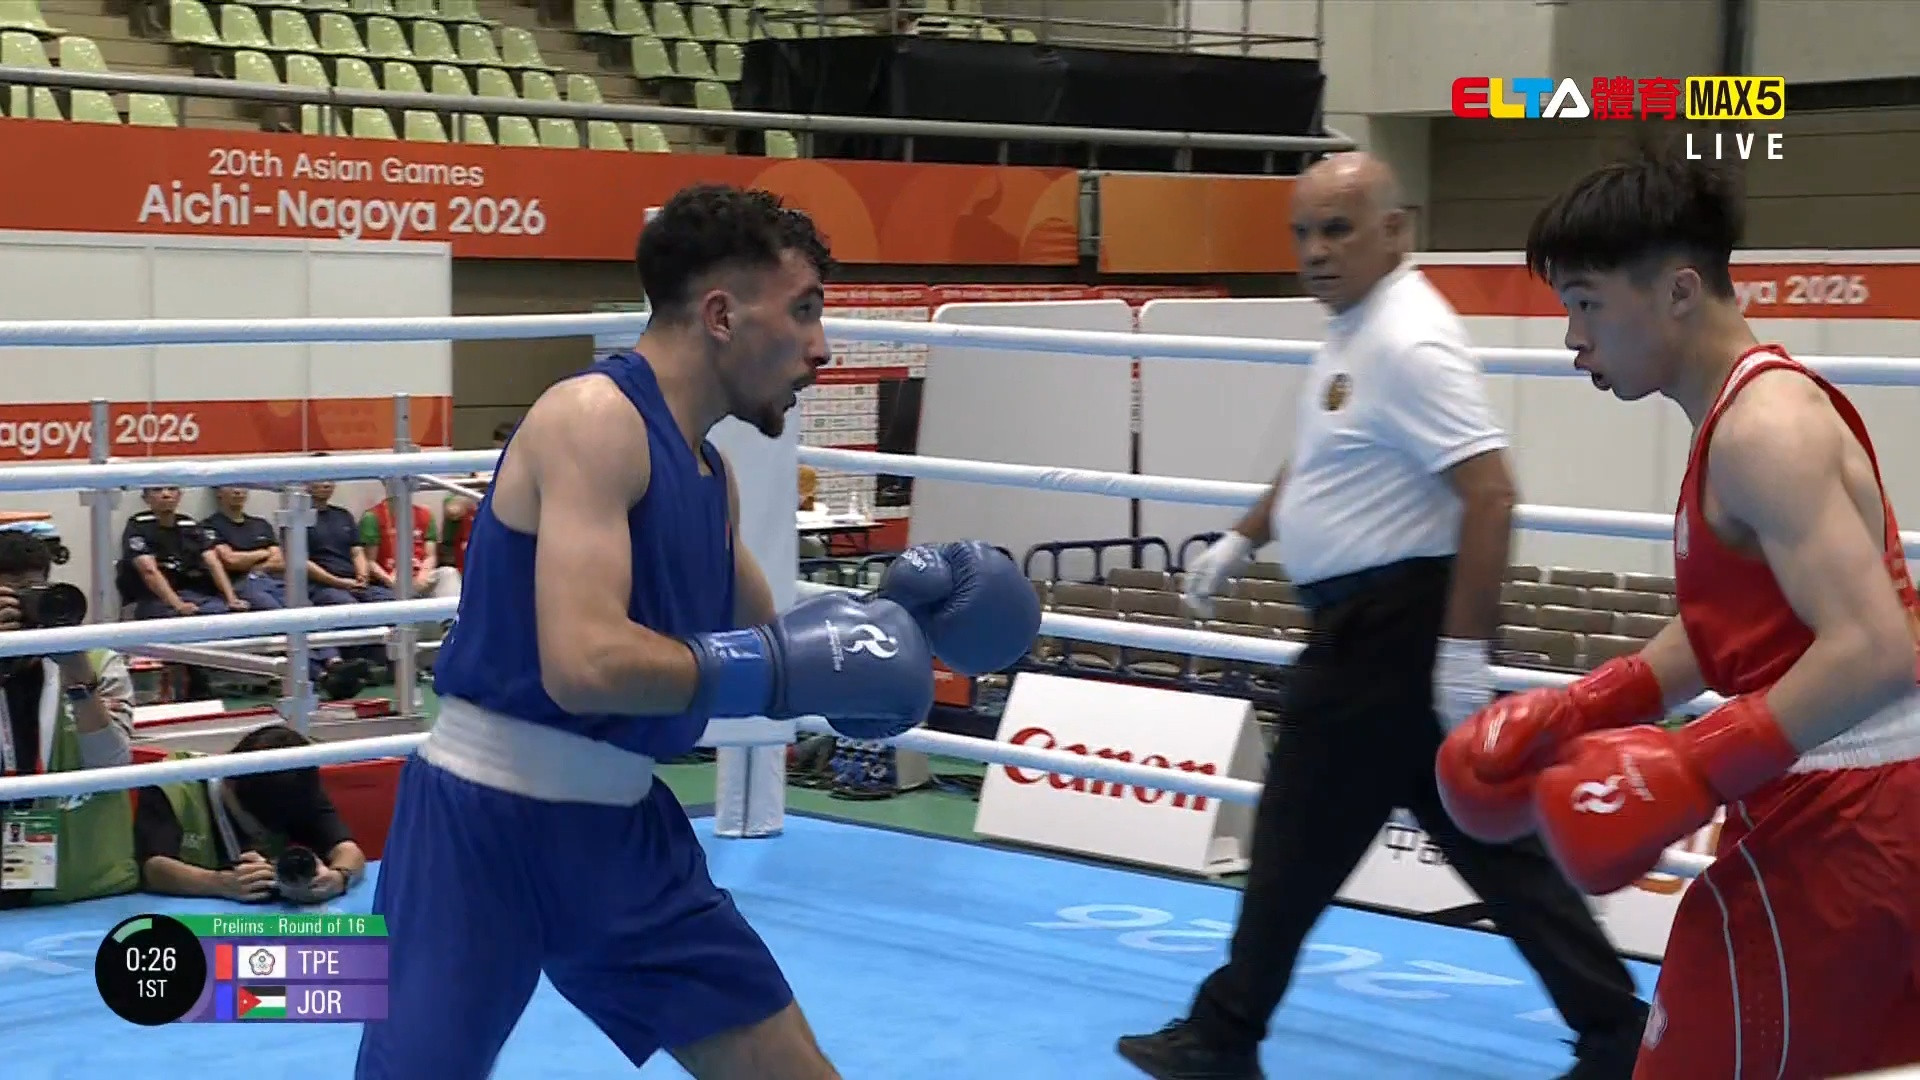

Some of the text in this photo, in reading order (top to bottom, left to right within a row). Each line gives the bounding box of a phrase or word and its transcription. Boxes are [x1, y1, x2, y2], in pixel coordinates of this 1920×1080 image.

[208, 148, 485, 188] 20th Asian Games
[137, 180, 547, 240] Aichi-Nagoya 2026
[1784, 274, 1871, 305] 2026
[115, 412, 201, 444] 2026
